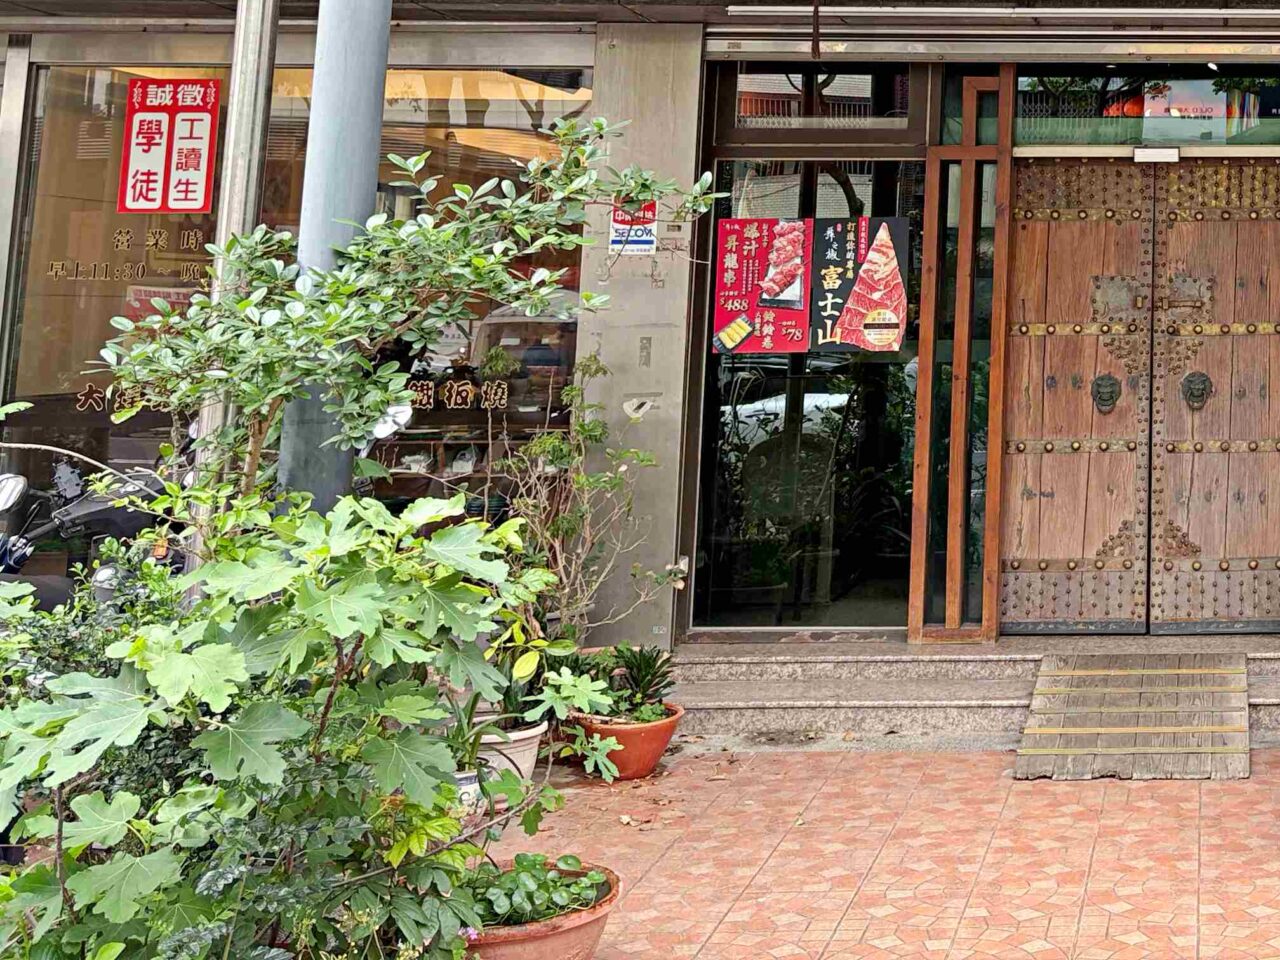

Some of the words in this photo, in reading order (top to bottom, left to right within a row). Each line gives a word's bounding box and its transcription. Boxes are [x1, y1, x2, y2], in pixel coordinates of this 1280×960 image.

[146, 84, 204, 107] 誠徵
[131, 119, 164, 203] 學徒
[173, 118, 204, 202] 工讀生
[614, 228, 652, 238] SECOM
[720, 298, 749, 311] $488
[817, 265, 844, 345] 富士山
